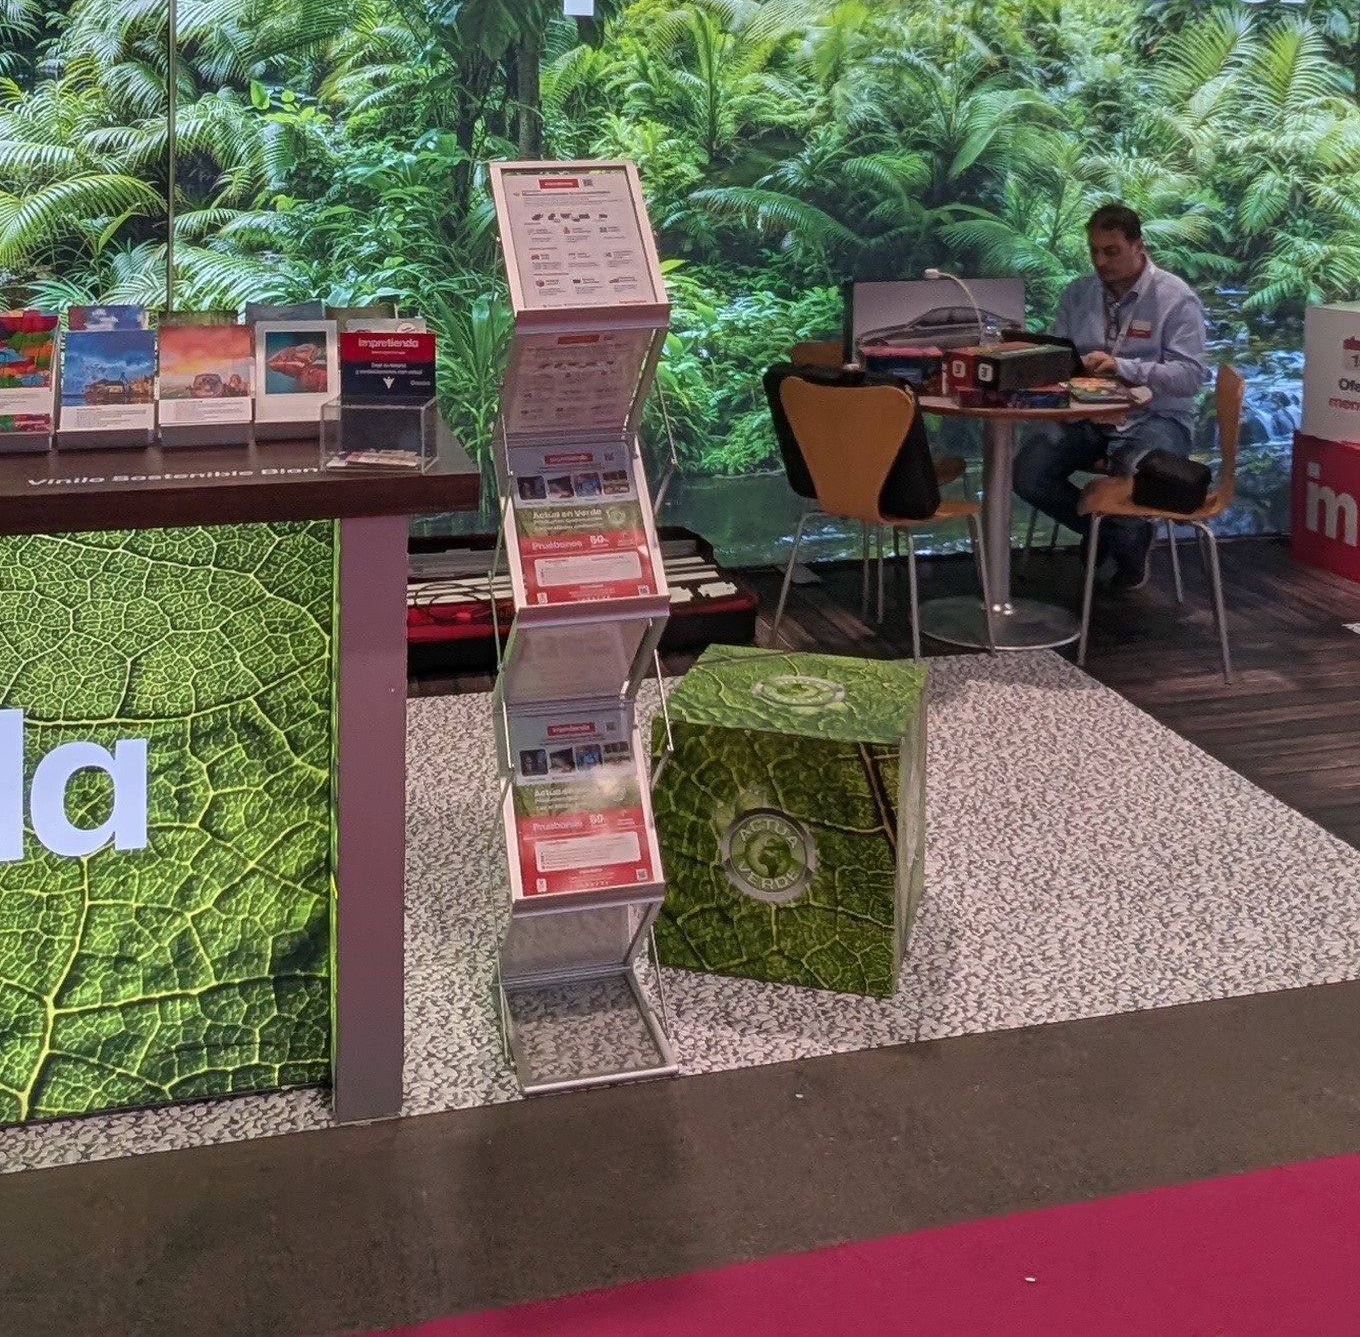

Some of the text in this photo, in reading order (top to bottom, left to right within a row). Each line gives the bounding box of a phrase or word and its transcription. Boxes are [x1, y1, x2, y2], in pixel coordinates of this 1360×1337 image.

[1306, 462, 1358, 547] im
[739, 819, 798, 848] ACTUA
[738, 860, 799, 890] VERDE
